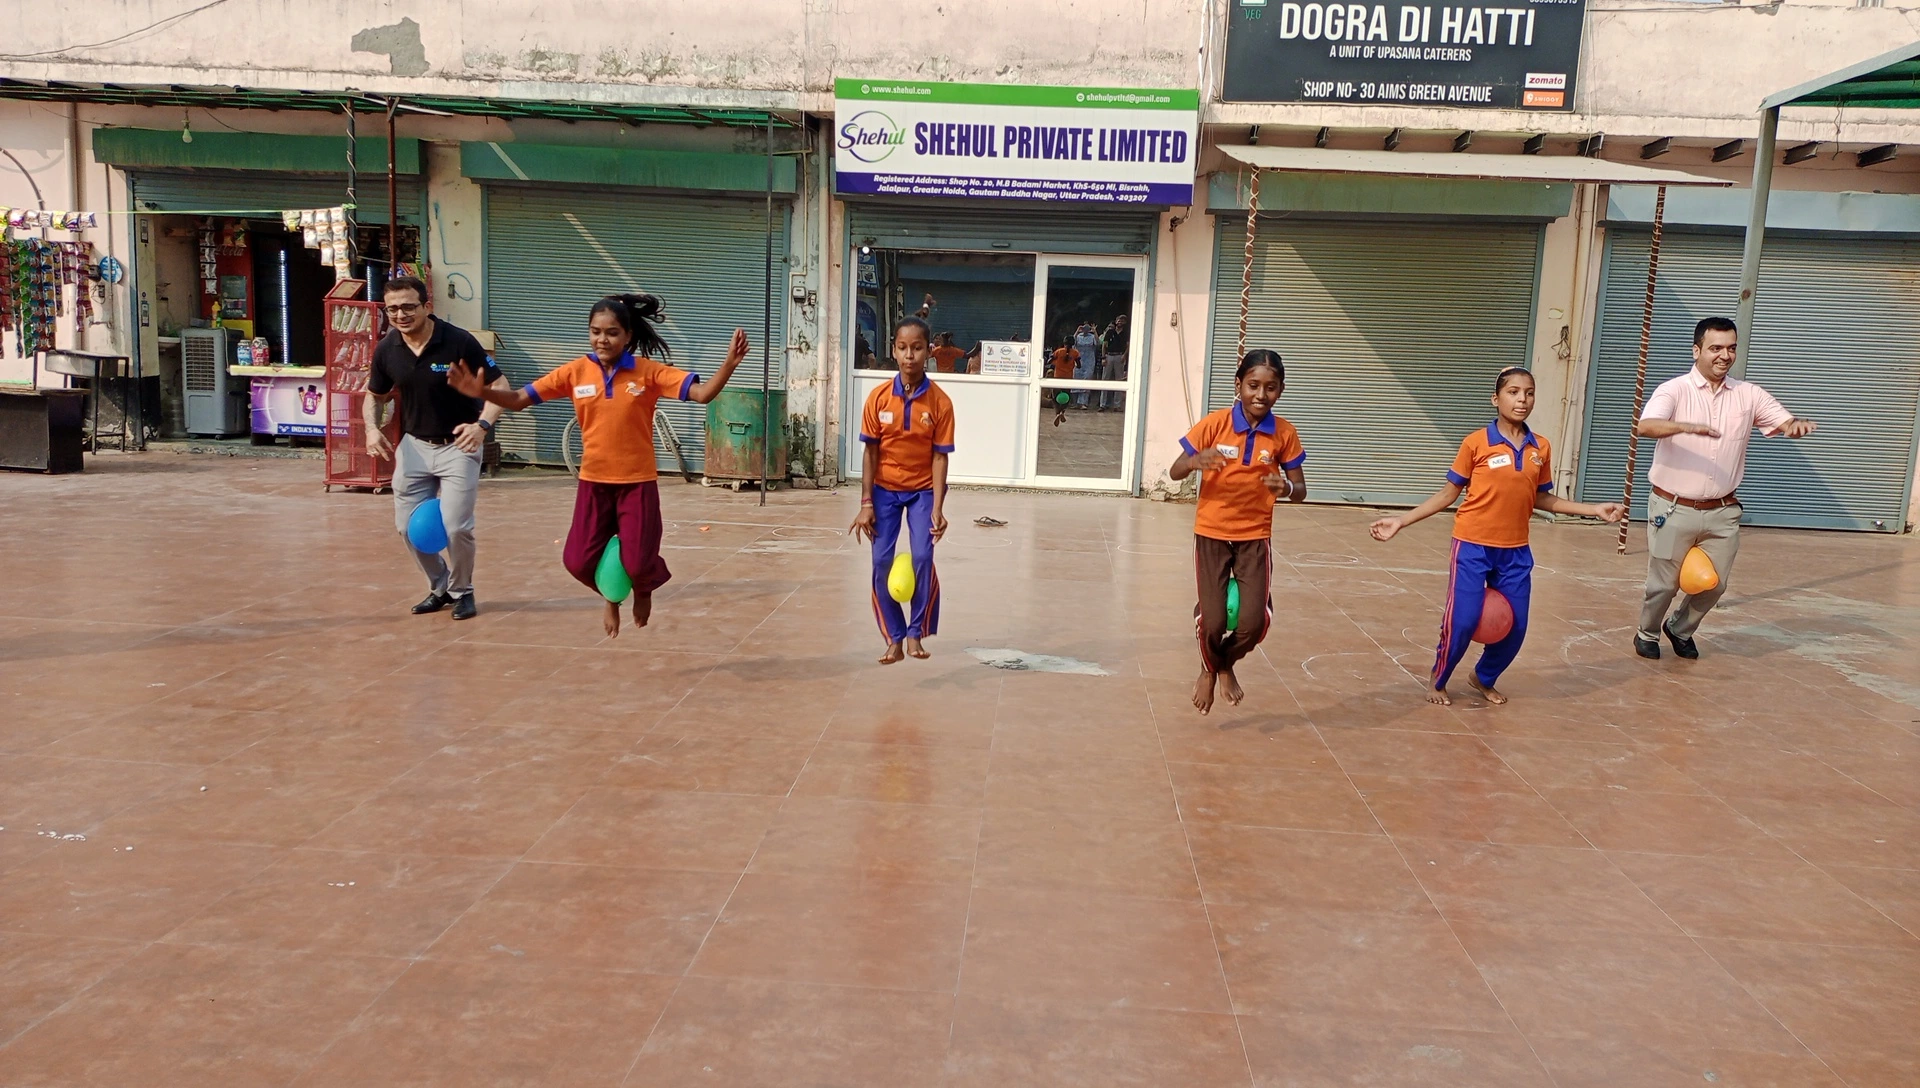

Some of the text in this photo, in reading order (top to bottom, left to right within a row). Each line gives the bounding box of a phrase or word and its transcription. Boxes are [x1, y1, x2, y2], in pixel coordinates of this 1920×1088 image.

[1245, 9, 1261, 20] VEG
[1280, 2, 1535, 46] DOGRA DI HATTI
[1329, 45, 1472, 62] A UNIT OF UPASANA CATERERS
[1529, 76, 1563, 84] zomato
[872, 86, 931, 95] www.shehul.com
[1086, 93, 1170, 104] shehulpvtltd@gmail.com
[1304, 81, 1492, 102] SHOP NO- 30 AIMS GREEN AVENUE
[838, 122, 906, 150] Shehul
[914, 122, 1188, 164] SHEHUL PRIVATE LIMITED
[874, 174, 914, 184] Registered
[914, 176, 948, 184] Address:
[949, 178, 968, 186] Shop
[1012, 180, 1042, 188] Badami
[1042, 181, 1072, 190] Market,
[877, 184, 912, 194] Jalalpur,
[912, 186, 942, 194] Greater
[942, 186, 967, 196] Noida,
[968, 188, 1000, 196] Gautam
[1001, 189, 1030, 198] Buddha
[1032, 190, 1058, 200] Nagar,
[1080, 192, 1114, 201] Pradesh,
